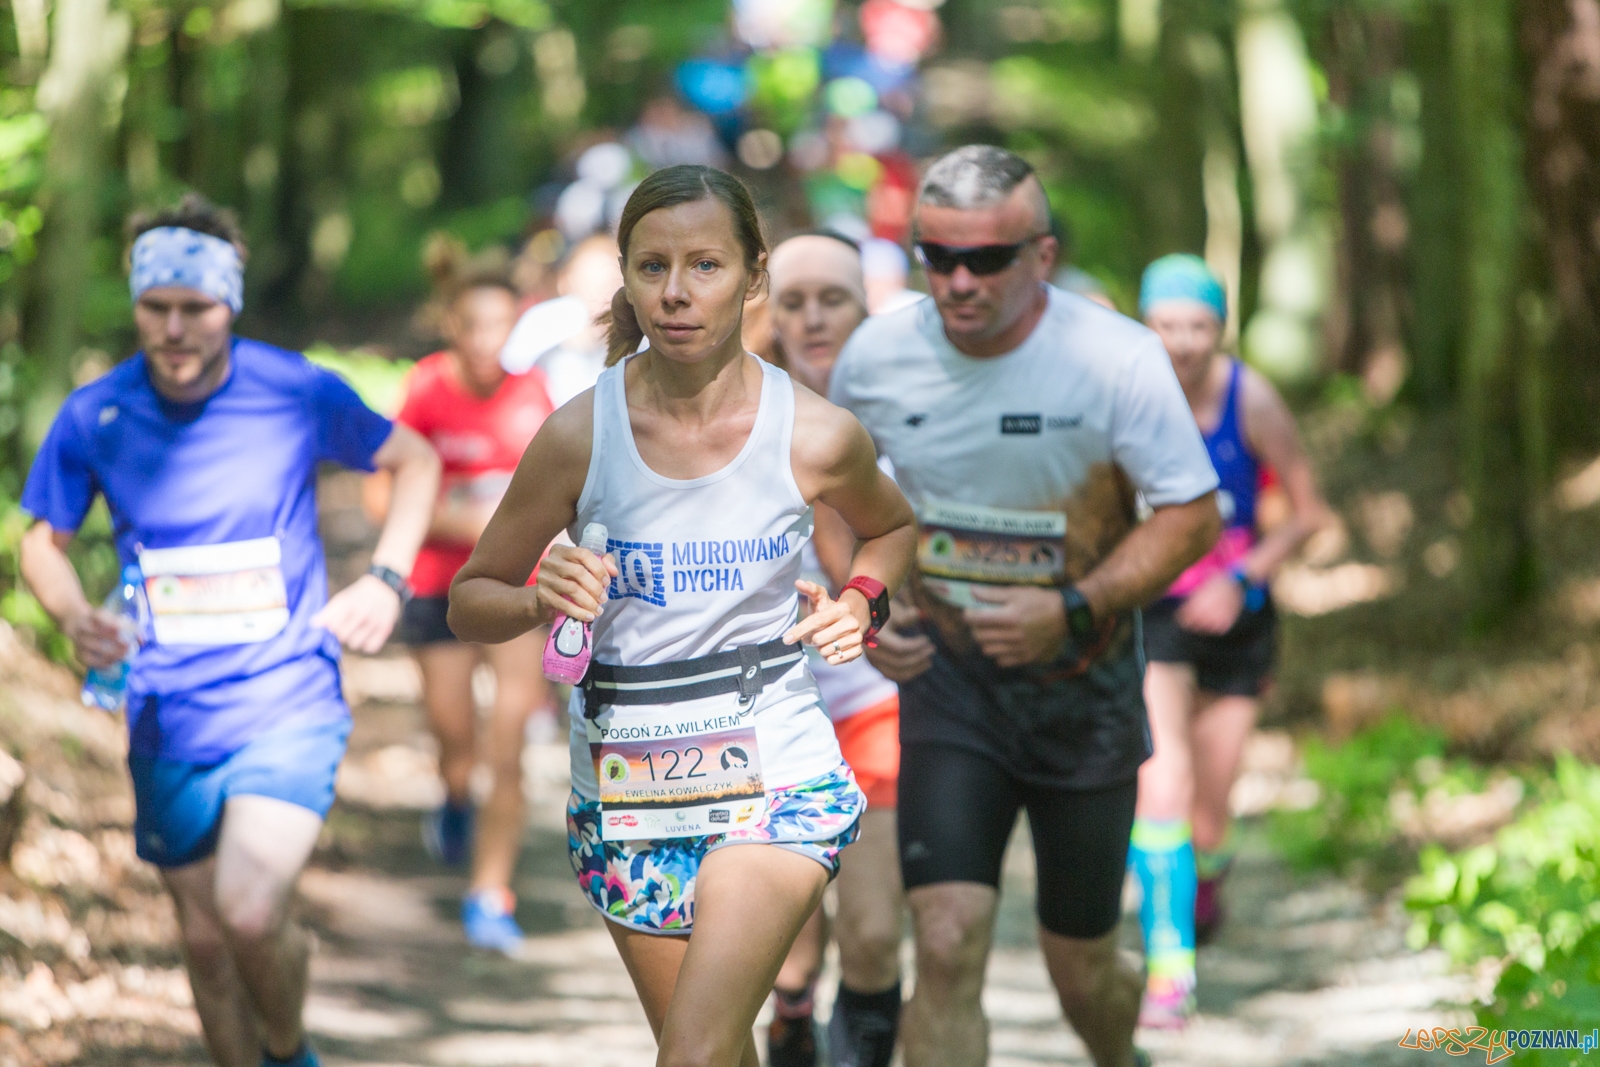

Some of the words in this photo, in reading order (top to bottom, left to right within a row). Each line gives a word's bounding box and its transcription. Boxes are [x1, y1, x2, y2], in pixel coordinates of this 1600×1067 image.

[672, 532, 790, 566] MUROWANA
[673, 568, 744, 592] DYCHA
[601, 723, 650, 740] POGOŃ
[654, 725, 673, 737] ZA
[675, 714, 741, 734] WILKIEM
[641, 746, 707, 782] 122
[625, 788, 667, 798] EWELINA
[668, 781, 733, 796] KOWALCZYK
[665, 824, 702, 833] LUVENA
